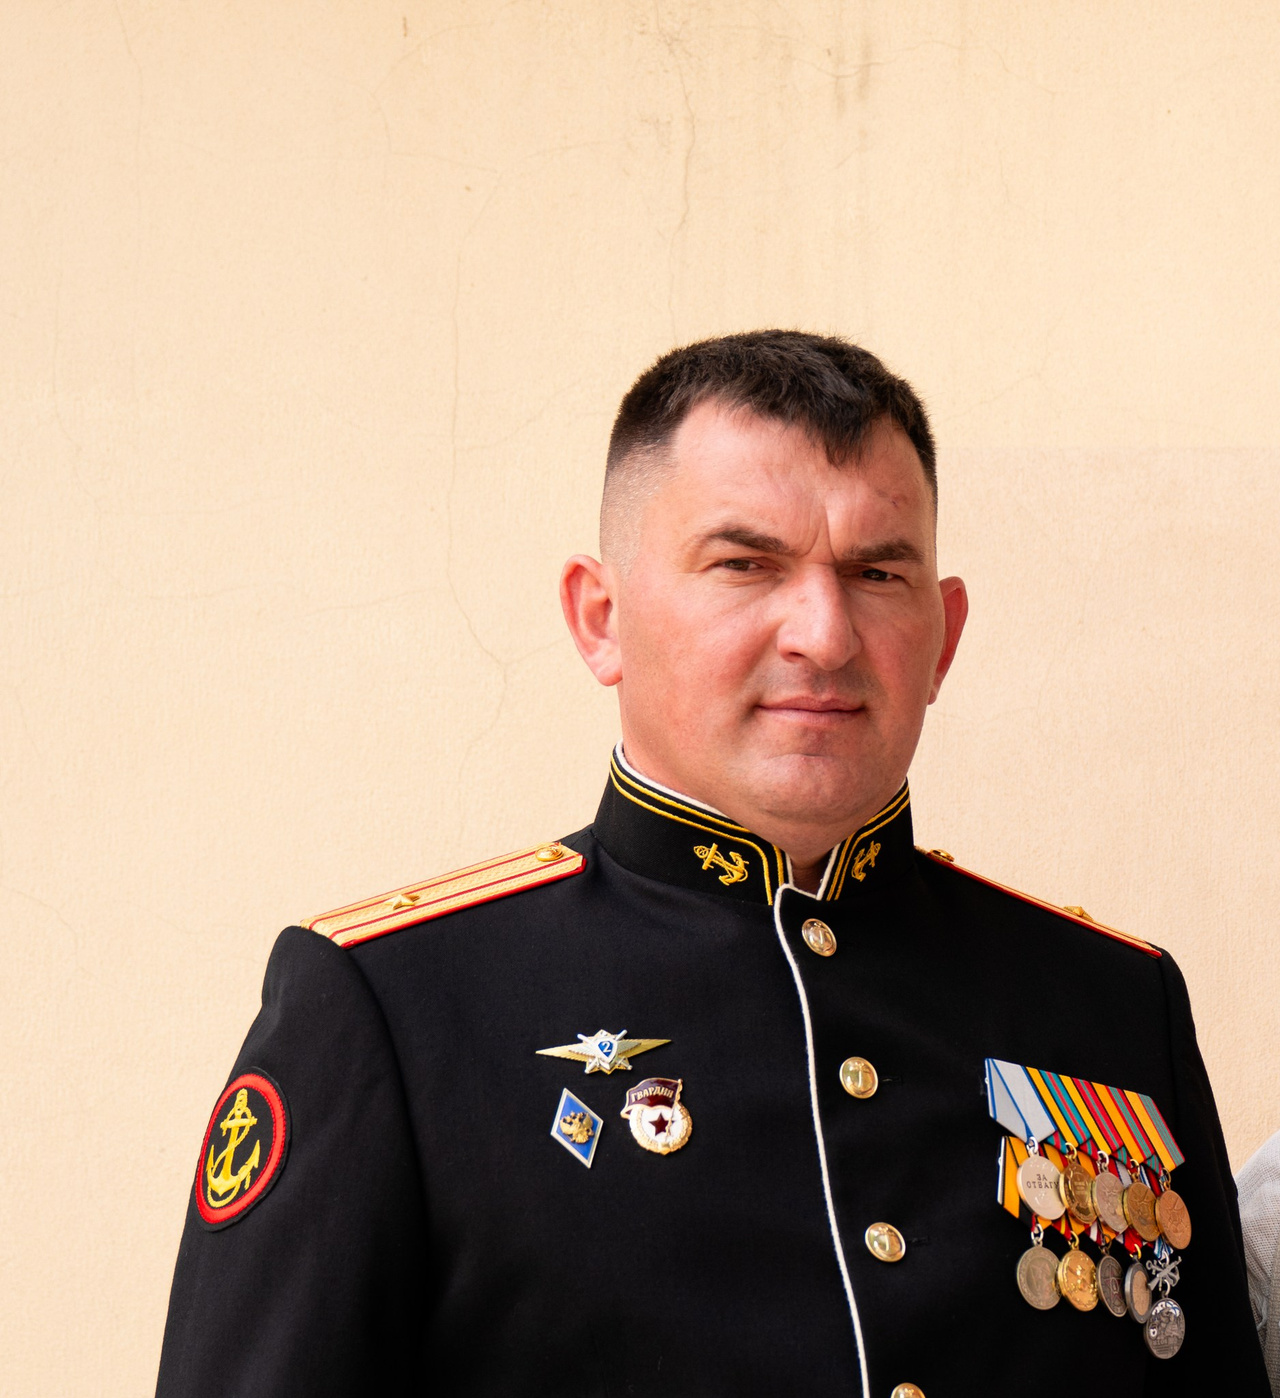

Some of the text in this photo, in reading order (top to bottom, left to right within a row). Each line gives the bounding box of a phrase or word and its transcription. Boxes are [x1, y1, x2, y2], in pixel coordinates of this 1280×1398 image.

[602, 1041, 612, 1053] 2
[631, 1086, 674, 1103] ГВАРДИЯ
[1036, 1173, 1048, 1181] ЗА
